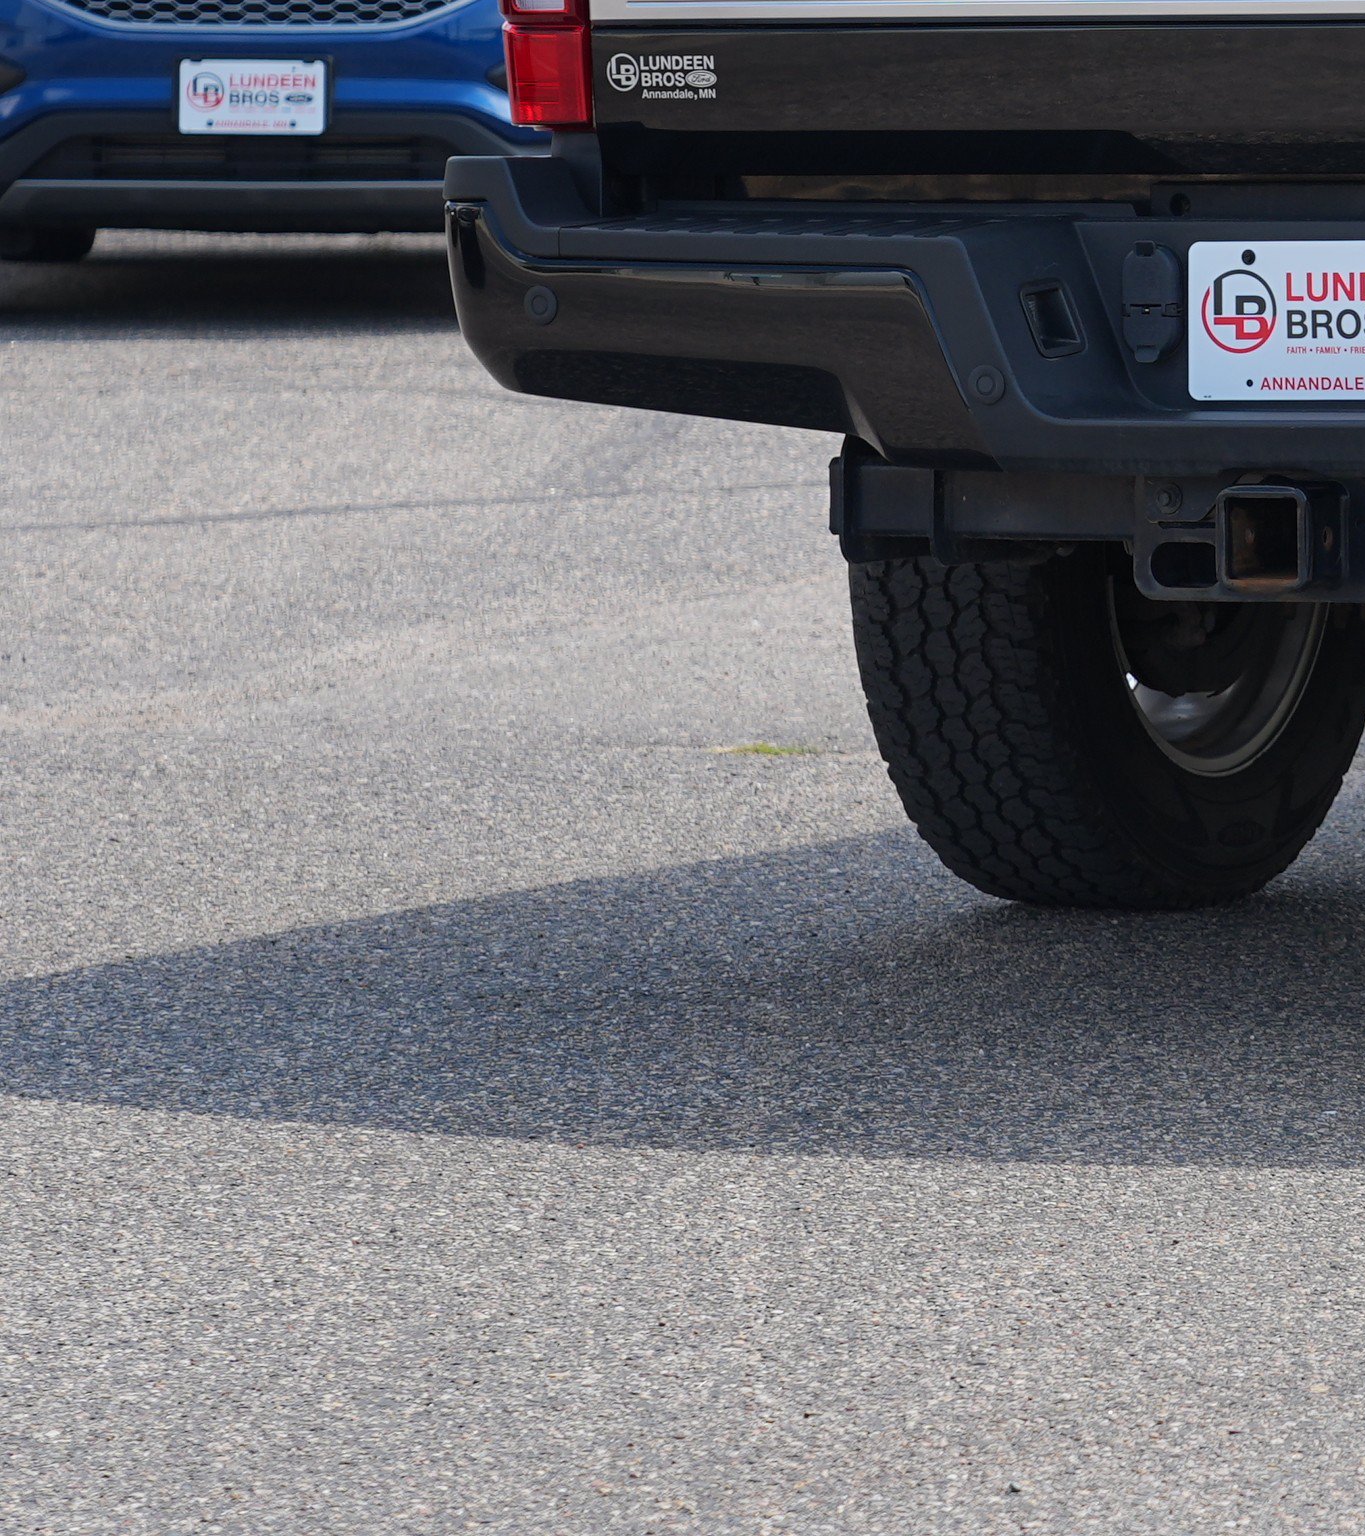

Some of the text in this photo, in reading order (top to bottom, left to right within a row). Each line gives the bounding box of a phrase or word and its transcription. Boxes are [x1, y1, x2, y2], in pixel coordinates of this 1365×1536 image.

[639, 55, 715, 71] LUNDEEN
[229, 73, 316, 88] LUNDEEN
[640, 71, 685, 87] BROS
[228, 90, 280, 105] BROS
[641, 88, 717, 101] Annandale, MN
[1286, 346, 1307, 354] FAITH
[1315, 346, 1341, 355] FAMILY
